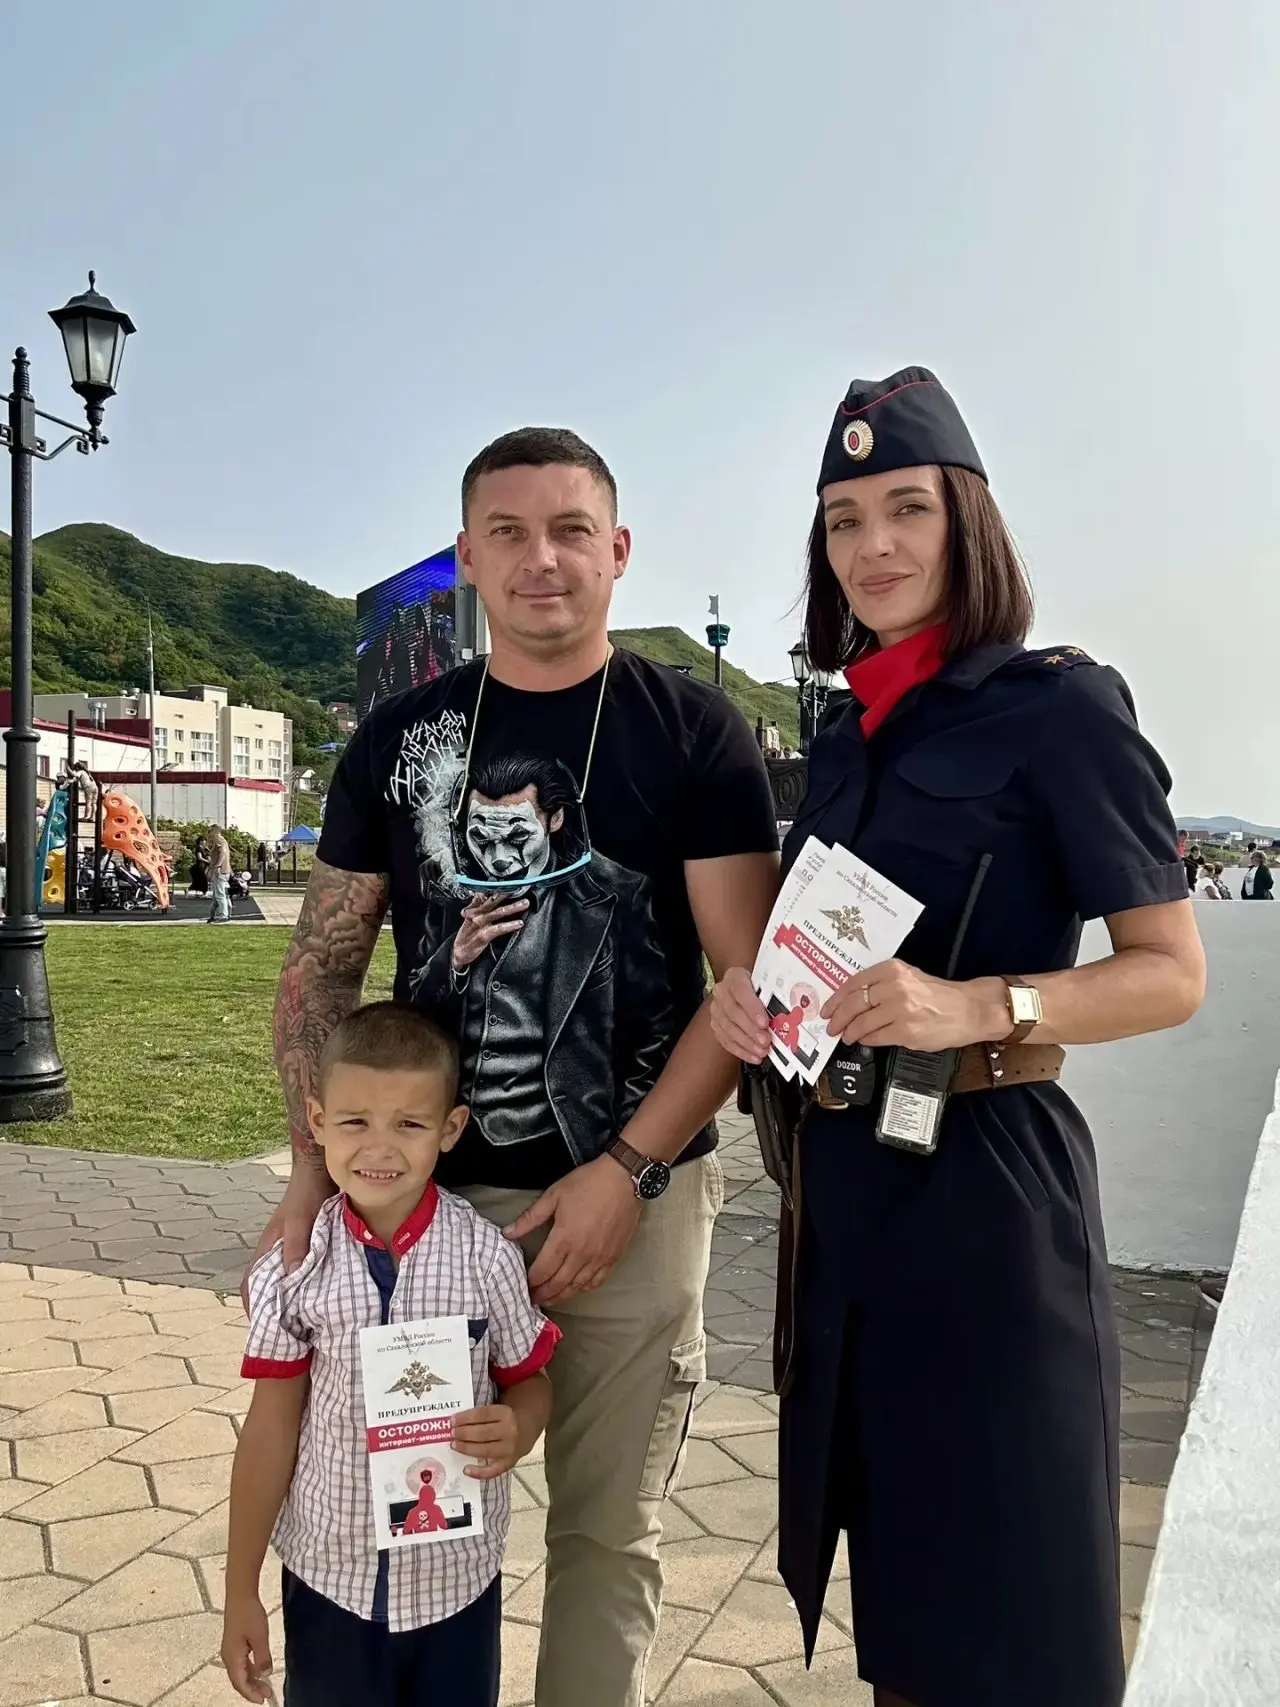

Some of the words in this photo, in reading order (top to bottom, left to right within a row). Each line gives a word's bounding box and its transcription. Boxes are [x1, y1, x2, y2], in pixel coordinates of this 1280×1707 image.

[795, 933, 849, 984] ОСТОРОЖН
[836, 1060, 862, 1072] DOZOR
[413, 1331, 435, 1341] России
[427, 1337, 452, 1346] области
[378, 1400, 462, 1419] ПРЕДУПРЕЖДАЕТ
[378, 1421, 451, 1438] ОСТОРОЖН
